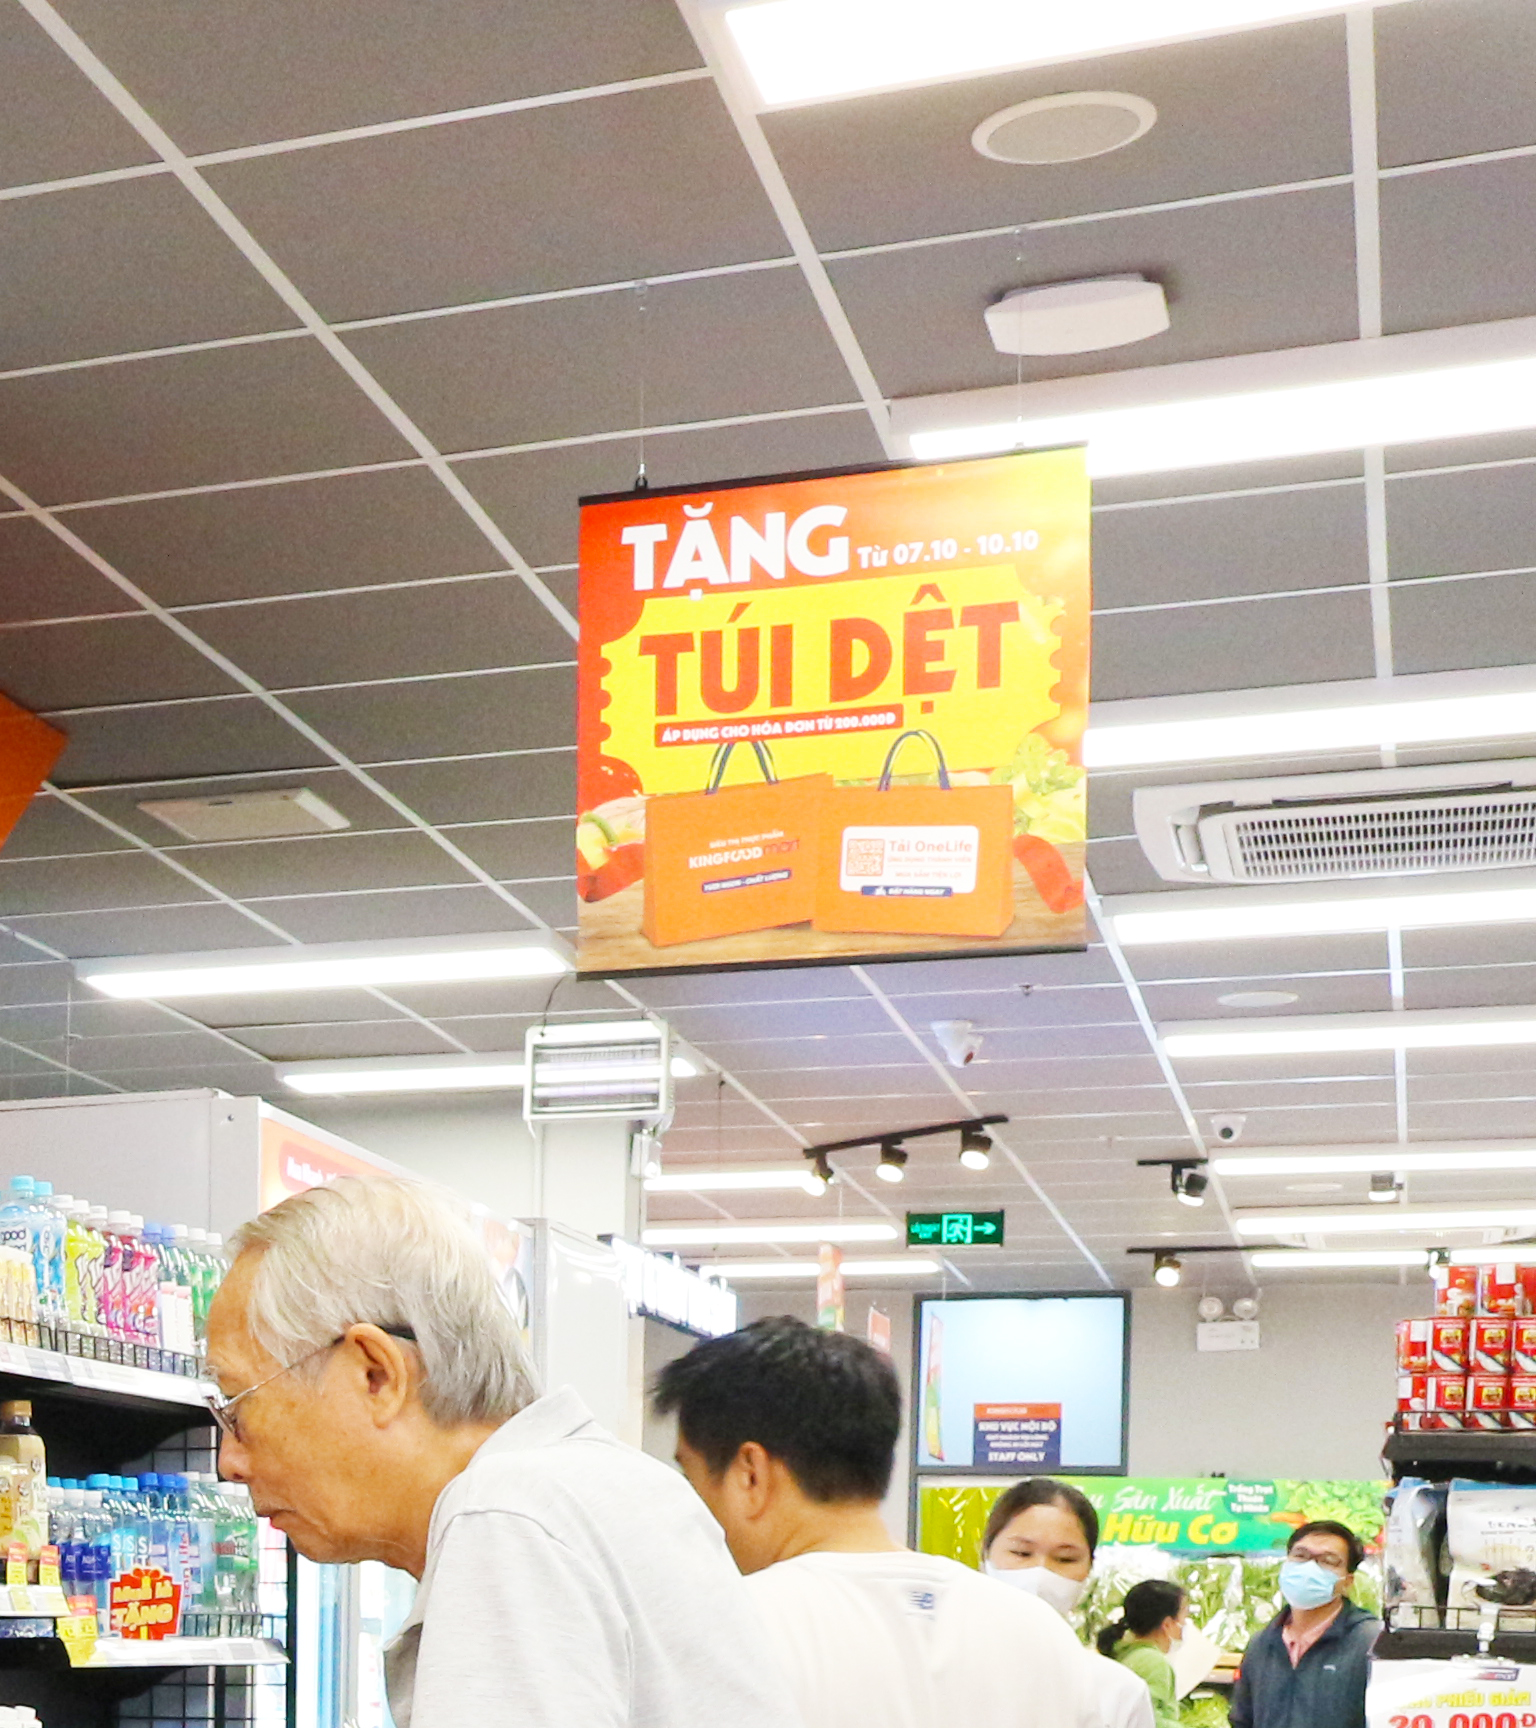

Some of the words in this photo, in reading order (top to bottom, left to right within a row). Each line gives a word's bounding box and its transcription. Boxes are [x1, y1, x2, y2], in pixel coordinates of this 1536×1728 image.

[621, 501, 850, 601] TẶNG
[857, 543, 890, 569] Từ
[893, 538, 958, 566] 07.10
[976, 529, 1039, 557] 10.10
[638, 602, 794, 717] TÚI
[829, 583, 1020, 715] DỆT
[661, 728, 682, 744] ÁP
[684, 725, 719, 743] DỤNG
[721, 723, 749, 737] CHO
[888, 840, 912, 853] Tải
[915, 840, 972, 853] OneLife
[1103, 1514, 1181, 1543] Hữu
[1187, 1514, 1239, 1544] Cơ
